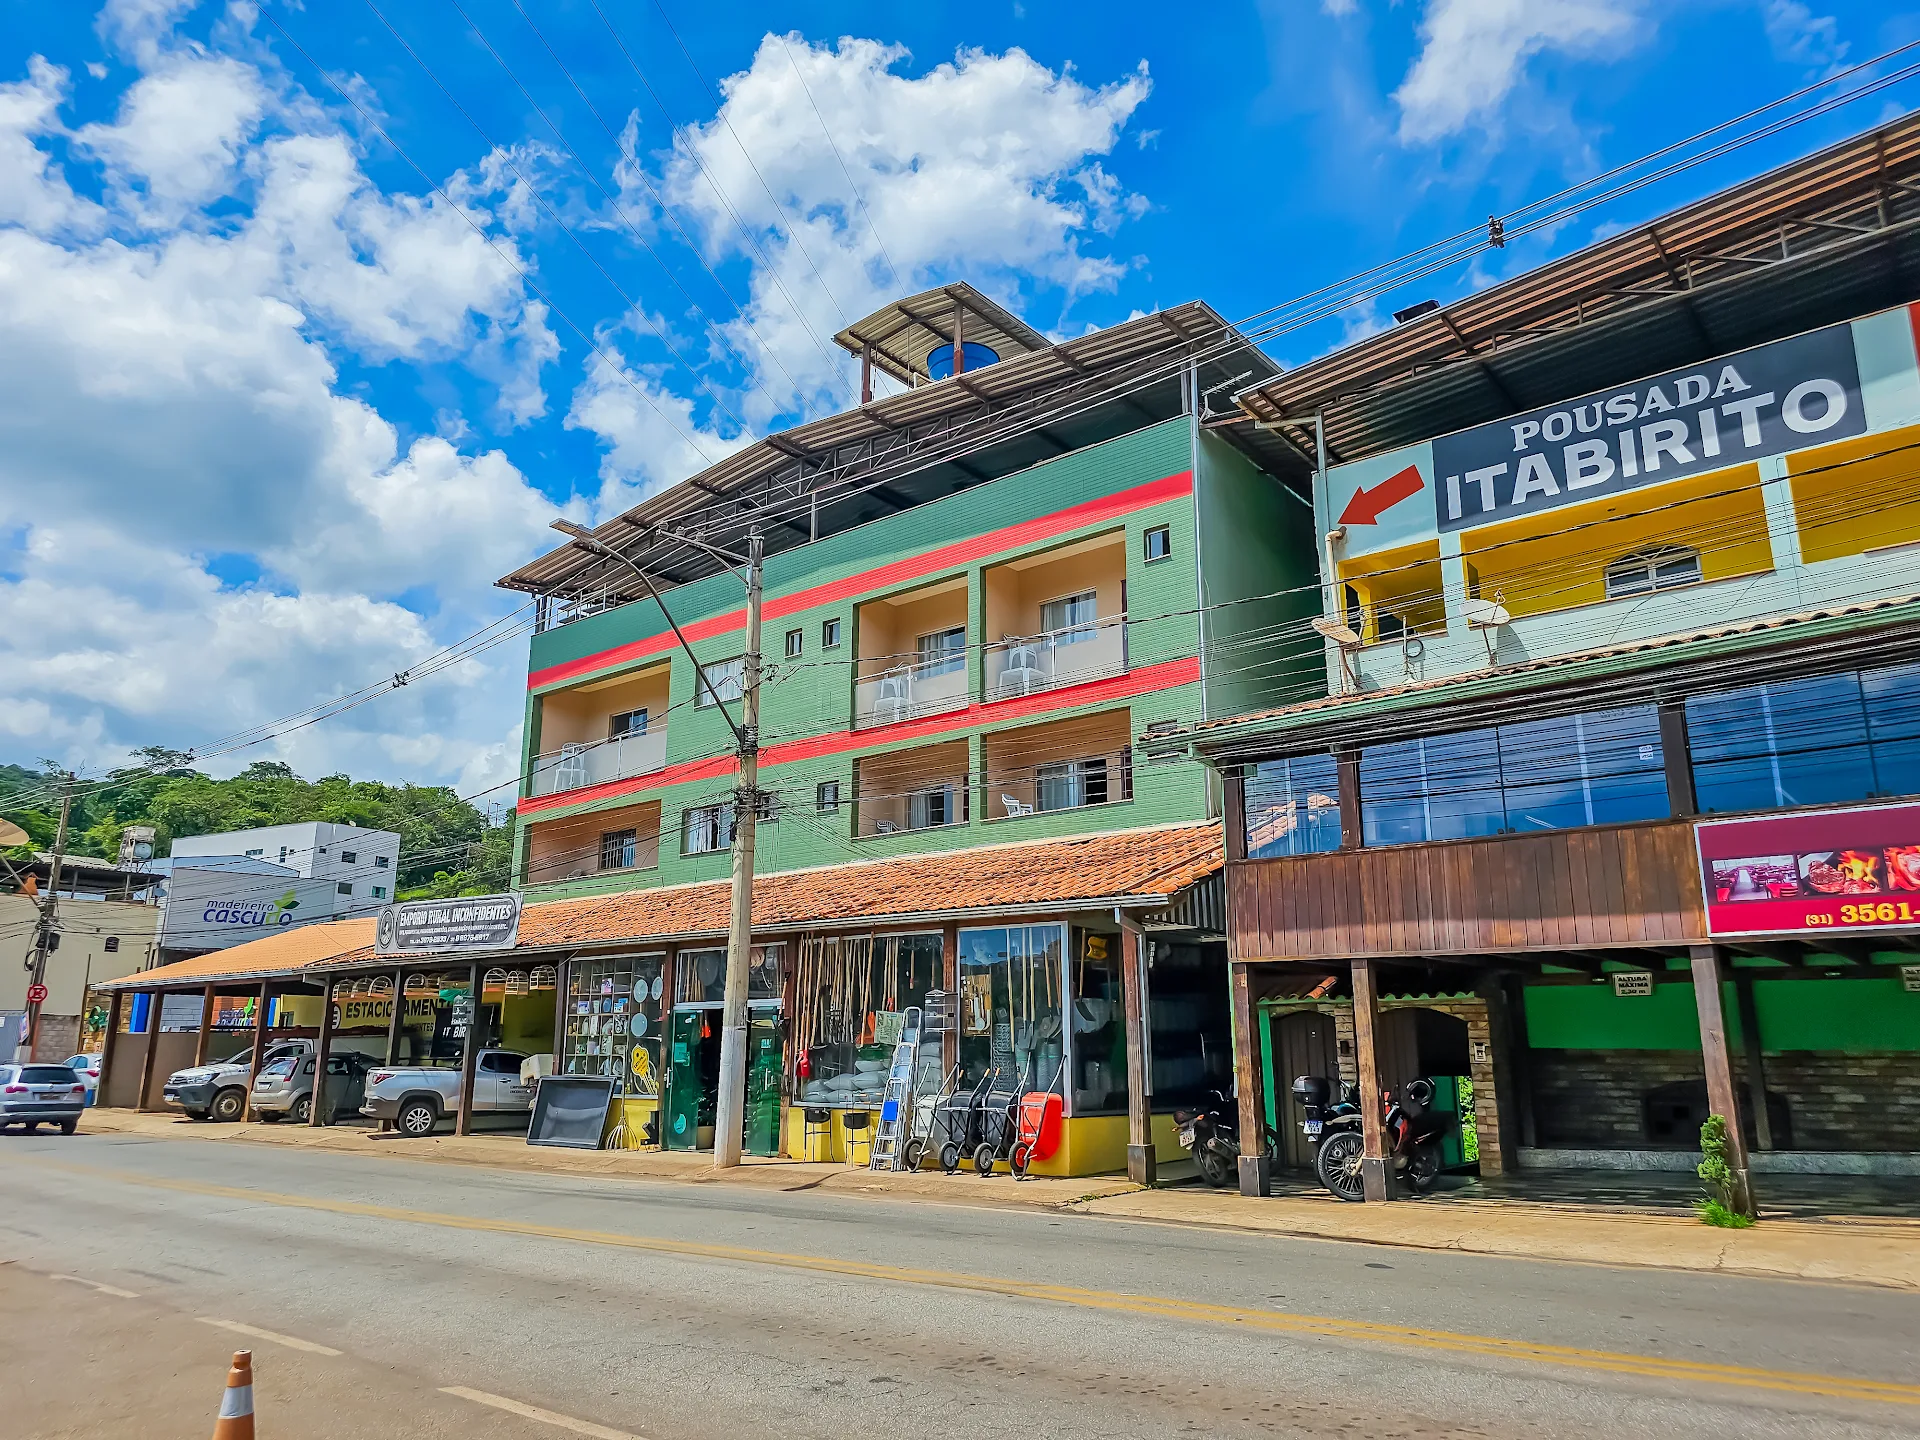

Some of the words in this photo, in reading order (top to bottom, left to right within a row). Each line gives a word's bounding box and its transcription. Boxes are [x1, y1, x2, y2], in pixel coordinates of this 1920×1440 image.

[1511, 365, 1751, 452] POUSADA
[1445, 378, 1848, 520] ITABIRITO
[206, 900, 274, 911] madeireira
[400, 908, 428, 926] EMPÓRIO
[428, 909, 450, 924] RURAL
[451, 905, 512, 923] INCONFIDENTES
[203, 907, 293, 926] cascudo
[1805, 913, 1834, 926] (31)
